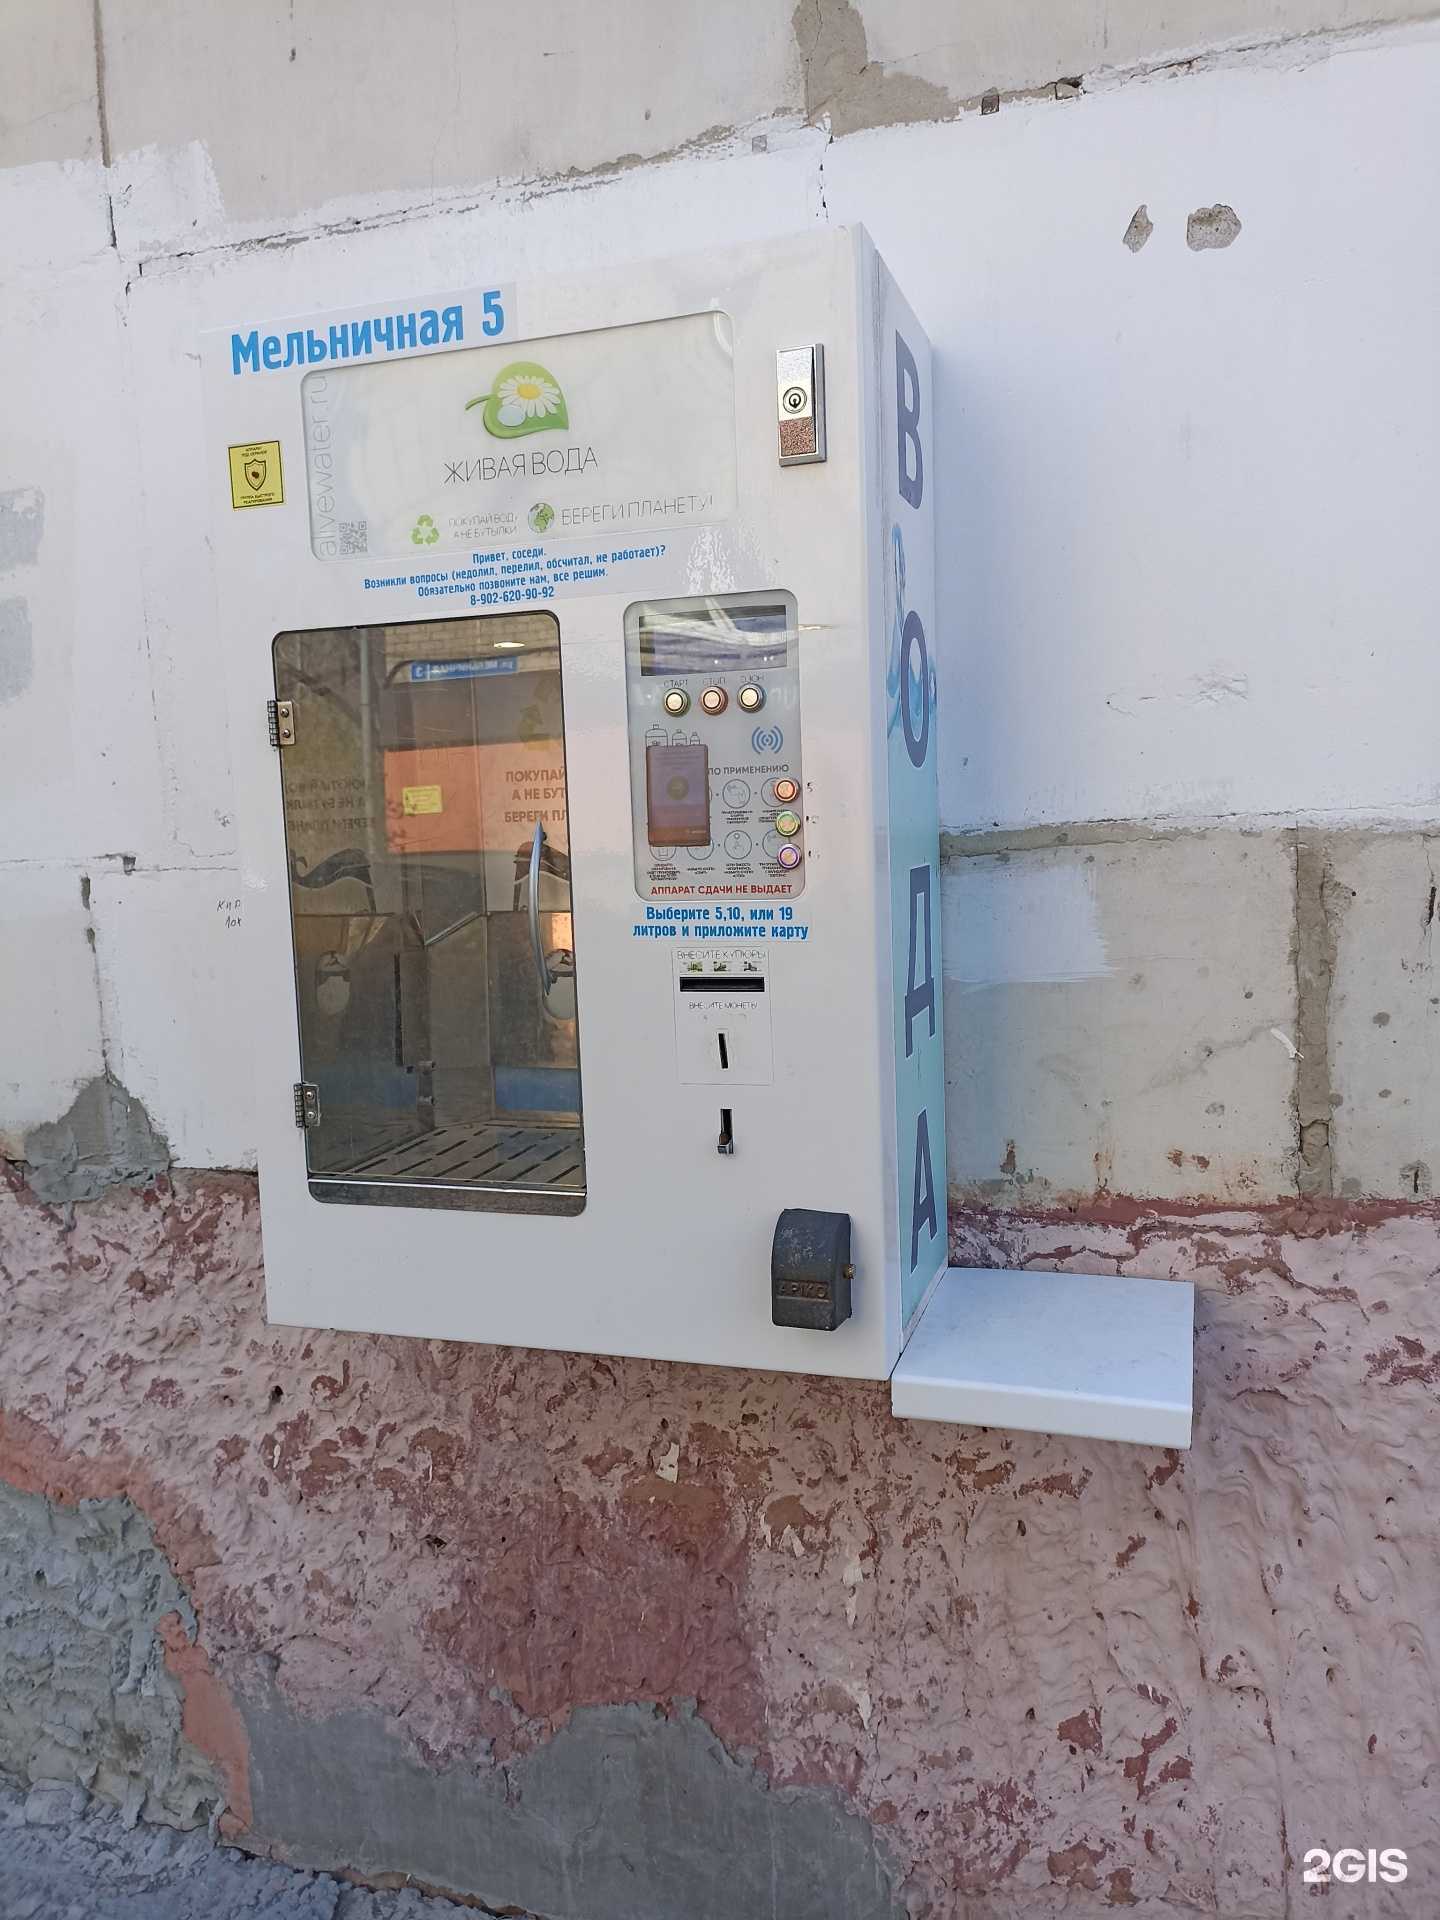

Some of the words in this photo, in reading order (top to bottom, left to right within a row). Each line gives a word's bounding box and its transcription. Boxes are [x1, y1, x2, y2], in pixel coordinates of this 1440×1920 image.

[232, 305, 464, 375] Мельничная
[482, 290, 504, 336] 5
[444, 453, 526, 484] ЖИВАЯ
[532, 447, 598, 475] ВОДА
[561, 503, 624, 526] БЕРЕГИ
[628, 494, 713, 519] ПЛАНЕТУ!
[364, 575, 407, 589] Возникли
[410, 572, 448, 585] вопросы
[501, 561, 543, 575] перелил,
[546, 555, 593, 570] обсчитал,
[596, 552, 608, 563] не
[611, 544, 666, 564] работает)?
[417, 581, 476, 597] Обязательно
[479, 576, 526, 592] позвоните
[553, 570, 569, 582] все
[470, 586, 555, 606] 8-902-620-90-92
[723, 764, 790, 775] ПРИМЕНЕНИЮ
[511, 789, 522, 800] А
[524, 788, 541, 800] НЕ
[504, 809, 549, 823] БЕРЕГИ
[651, 885, 695, 895] АППАРАТ
[698, 885, 733, 896] СДАЧИ
[735, 885, 748, 894] НЕ
[751, 884, 793, 895] ВЫДАЕТ
[646, 906, 710, 922] Выберите
[715, 907, 745, 922] 5,10,
[750, 908, 774, 921] или
[779, 906, 793, 921] 19
[633, 924, 677, 939] литров
[682, 925, 690, 937] и
[694, 924, 766, 939] приложите
[771, 925, 809, 940] карту
